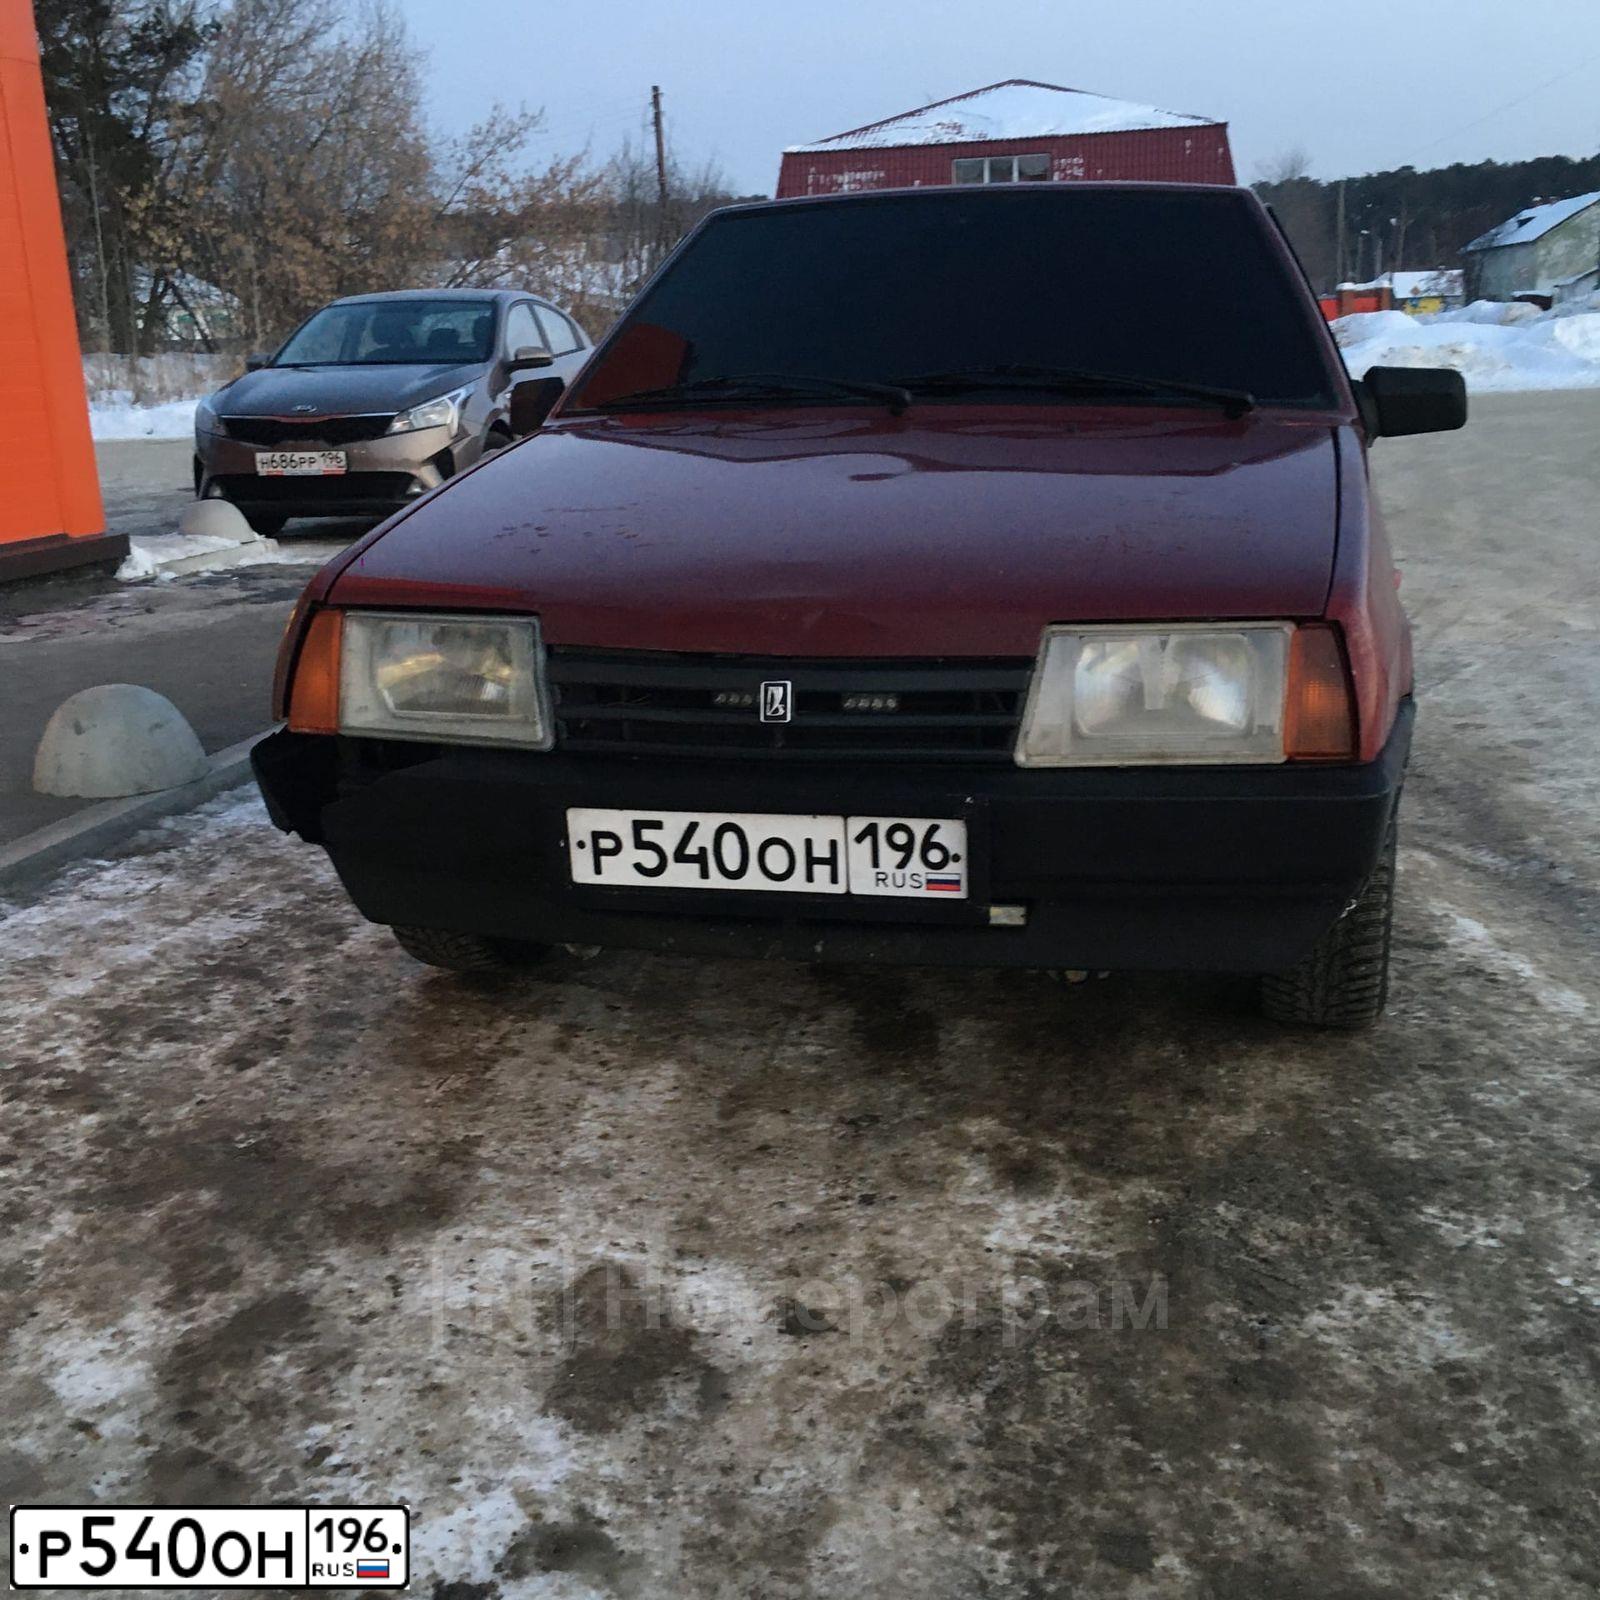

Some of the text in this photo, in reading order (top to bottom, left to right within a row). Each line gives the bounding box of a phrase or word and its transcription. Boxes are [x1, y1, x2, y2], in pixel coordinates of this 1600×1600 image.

[320, 452, 343, 464] 196
[590, 819, 950, 885] Р540ОН 196
[875, 871, 924, 889] RUS
